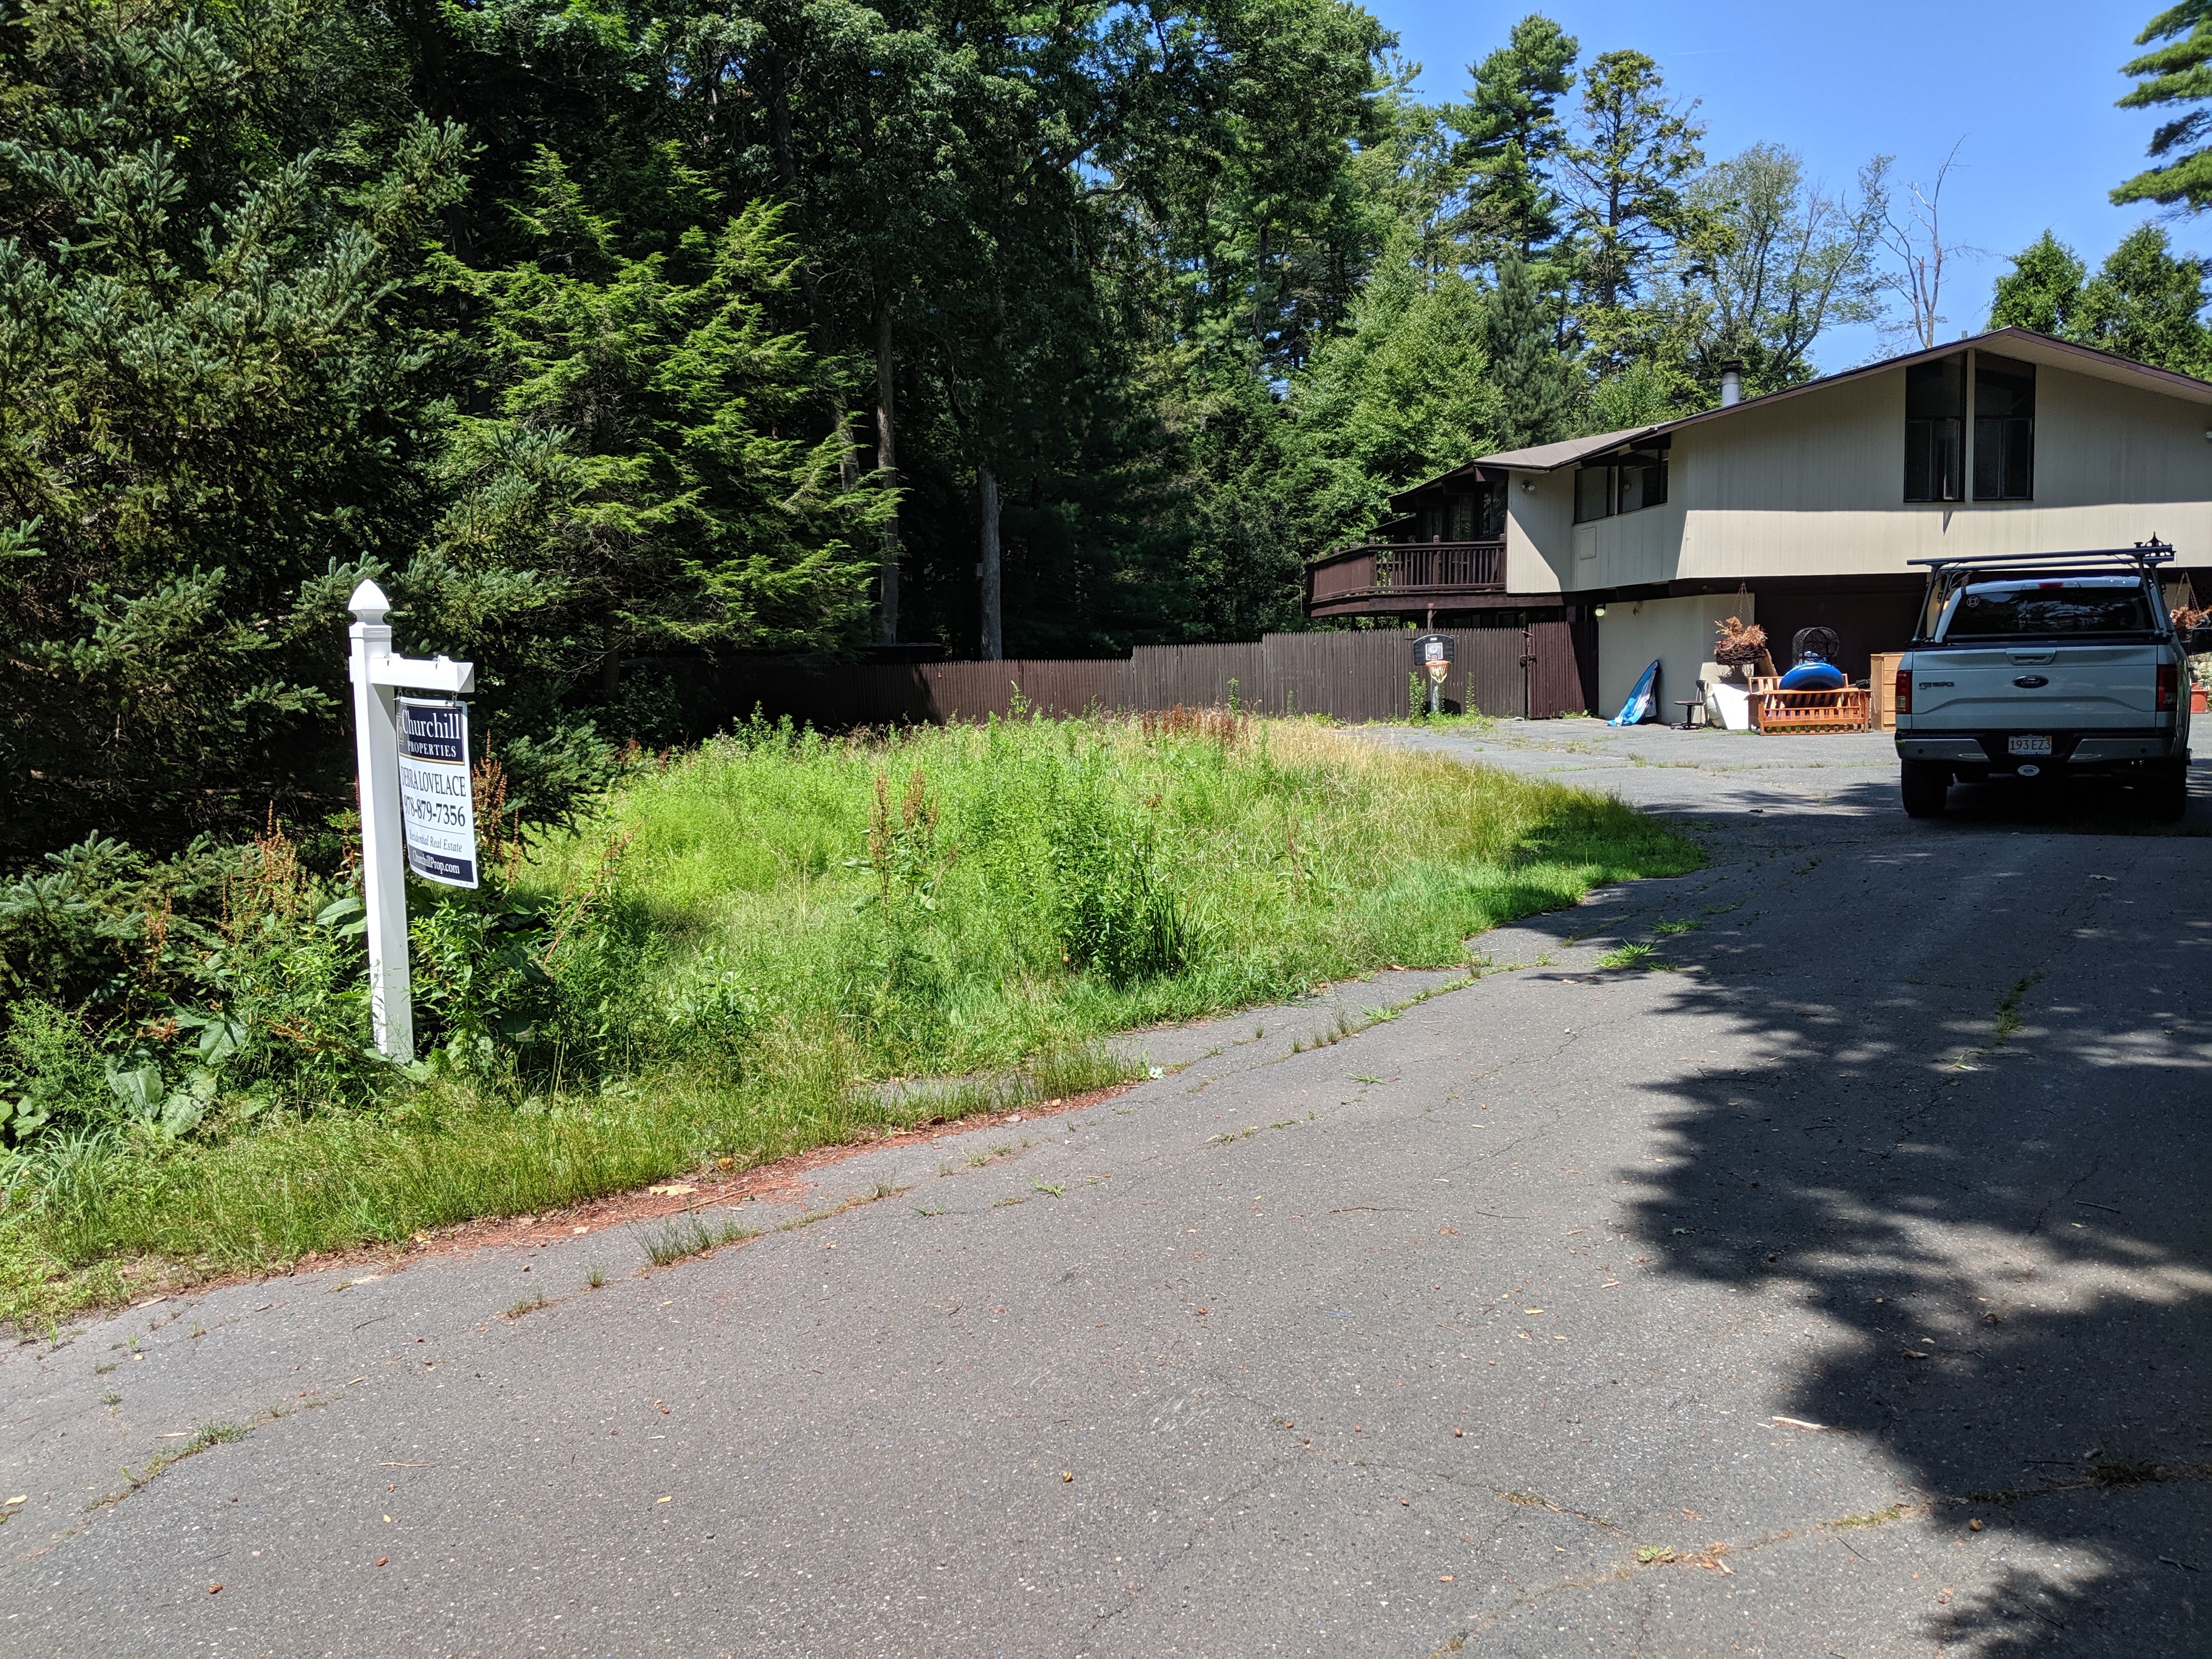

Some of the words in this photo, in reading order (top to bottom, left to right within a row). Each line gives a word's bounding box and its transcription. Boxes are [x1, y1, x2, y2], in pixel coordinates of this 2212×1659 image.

[402, 709, 460, 739] Churchill
[407, 740, 456, 758] PROPERTIES
[2010, 740, 2029, 750] 193
[2032, 740, 2050, 750] EZ3
[400, 766, 419, 790] DEBRA
[418, 771, 466, 797] LOVELACE
[404, 794, 465, 827] 978-879-7356
[409, 829, 428, 845] Residential
[430, 836, 442, 849] Real
[443, 839, 462, 853] Estate
[413, 850, 460, 874] ChurchillProp.com
